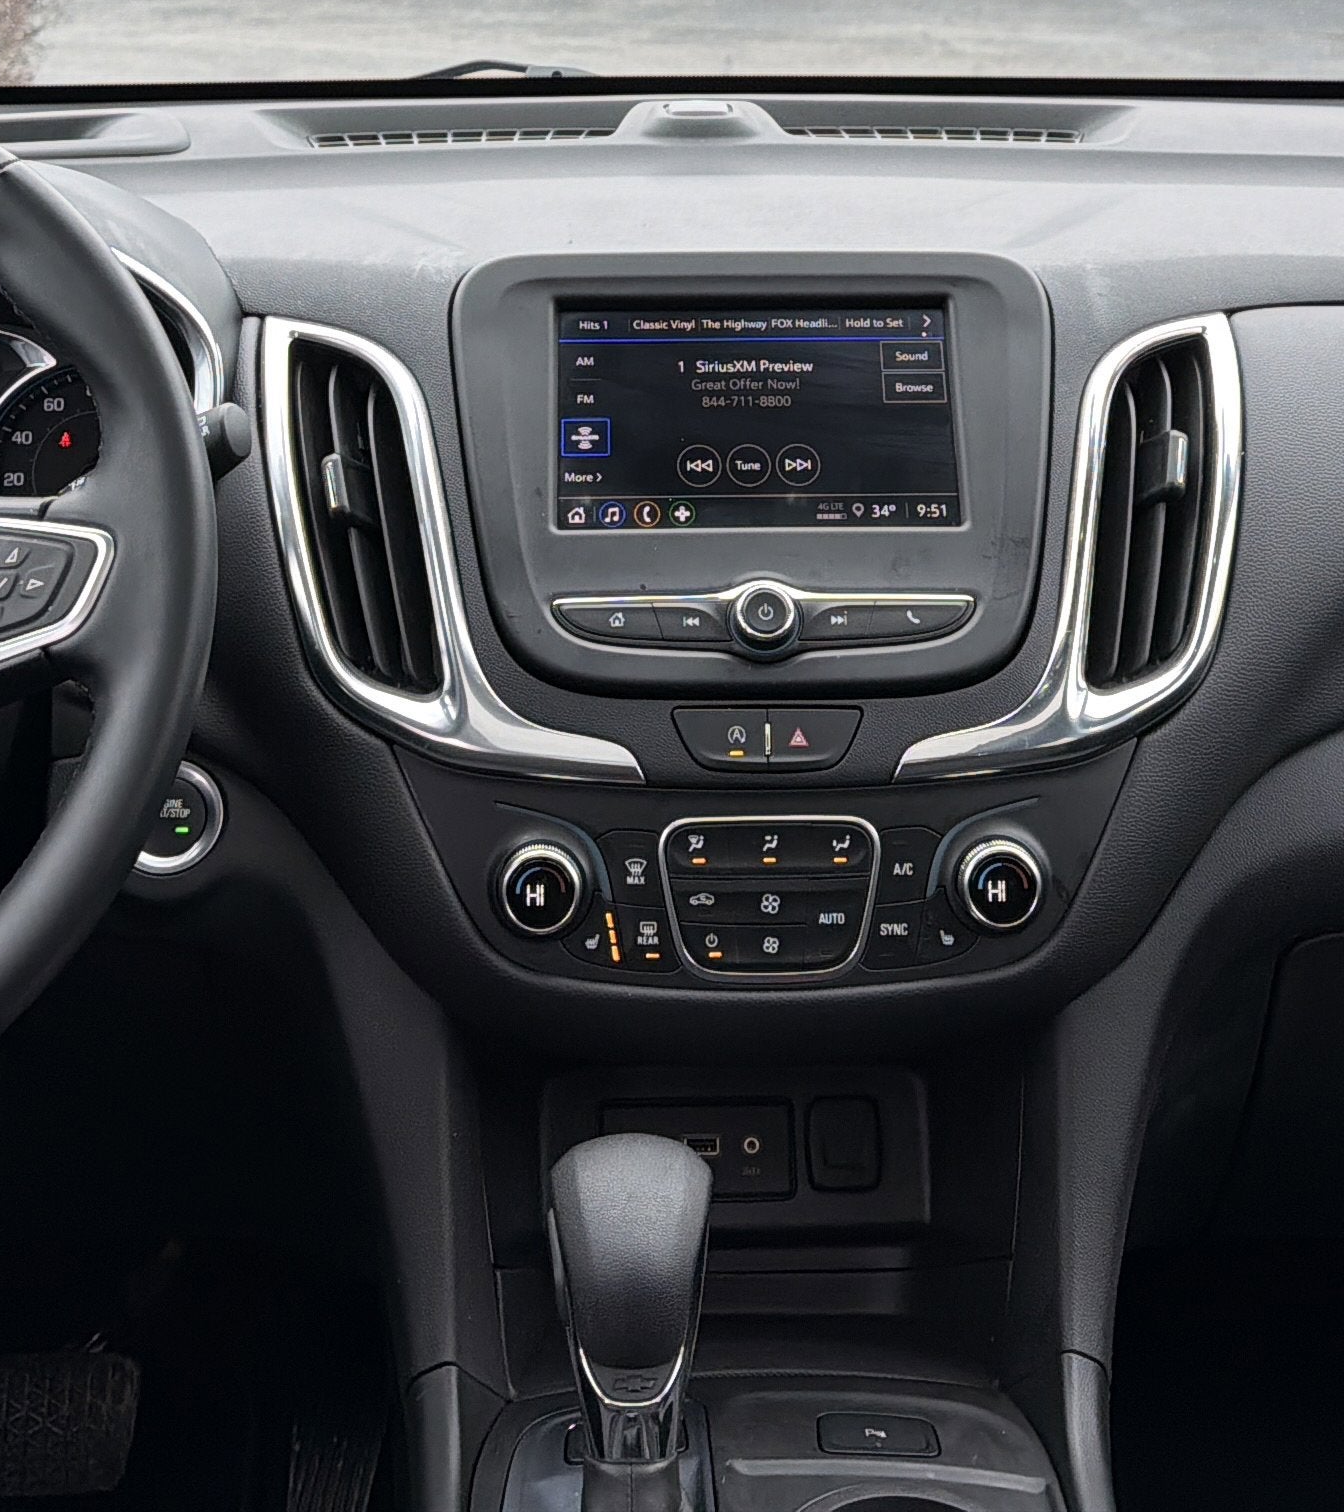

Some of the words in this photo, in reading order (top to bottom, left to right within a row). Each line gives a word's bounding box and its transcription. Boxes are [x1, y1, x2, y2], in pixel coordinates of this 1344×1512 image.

[579, 320, 600, 330] Hits
[602, 320, 608, 330] 1
[632, 319, 669, 330] Classic
[669, 319, 695, 332] Vinyl
[701, 319, 722, 329] The
[723, 319, 767, 332] Highway
[771, 318, 793, 328] FOX
[795, 318, 838, 328] Headli...
[845, 318, 870, 328] Hold
[872, 319, 884, 328] to
[886, 318, 904, 328] Set
[575, 356, 595, 367] AM
[895, 350, 929, 362] Sound
[677, 360, 685, 373] 1
[695, 359, 757, 373] SiriusXM
[759, 359, 814, 373] Preview
[691, 379, 726, 391] Great
[729, 378, 763, 390] Offer
[767, 377, 800, 390] Now!
[895, 382, 934, 393] Browse
[42, 397, 65, 412] 60
[576, 394, 595, 404] FM
[701, 395, 792, 409] 844-711-8800
[11, 430, 33, 445] 40
[735, 460, 762, 471] Tune
[3, 472, 25, 487] 20
[564, 472, 594, 483] More
[817, 502, 830, 512] 4G
[830, 502, 844, 511] LTE
[916, 503, 948, 518] 9:51
[893, 862, 914, 876] A/C
[626, 875, 646, 885] MAX
[525, 882, 546, 907] HI
[987, 880, 1008, 903] HI
[818, 912, 845, 925] AUTO
[879, 923, 909, 936] SYNC
[637, 935, 660, 945] REAR
